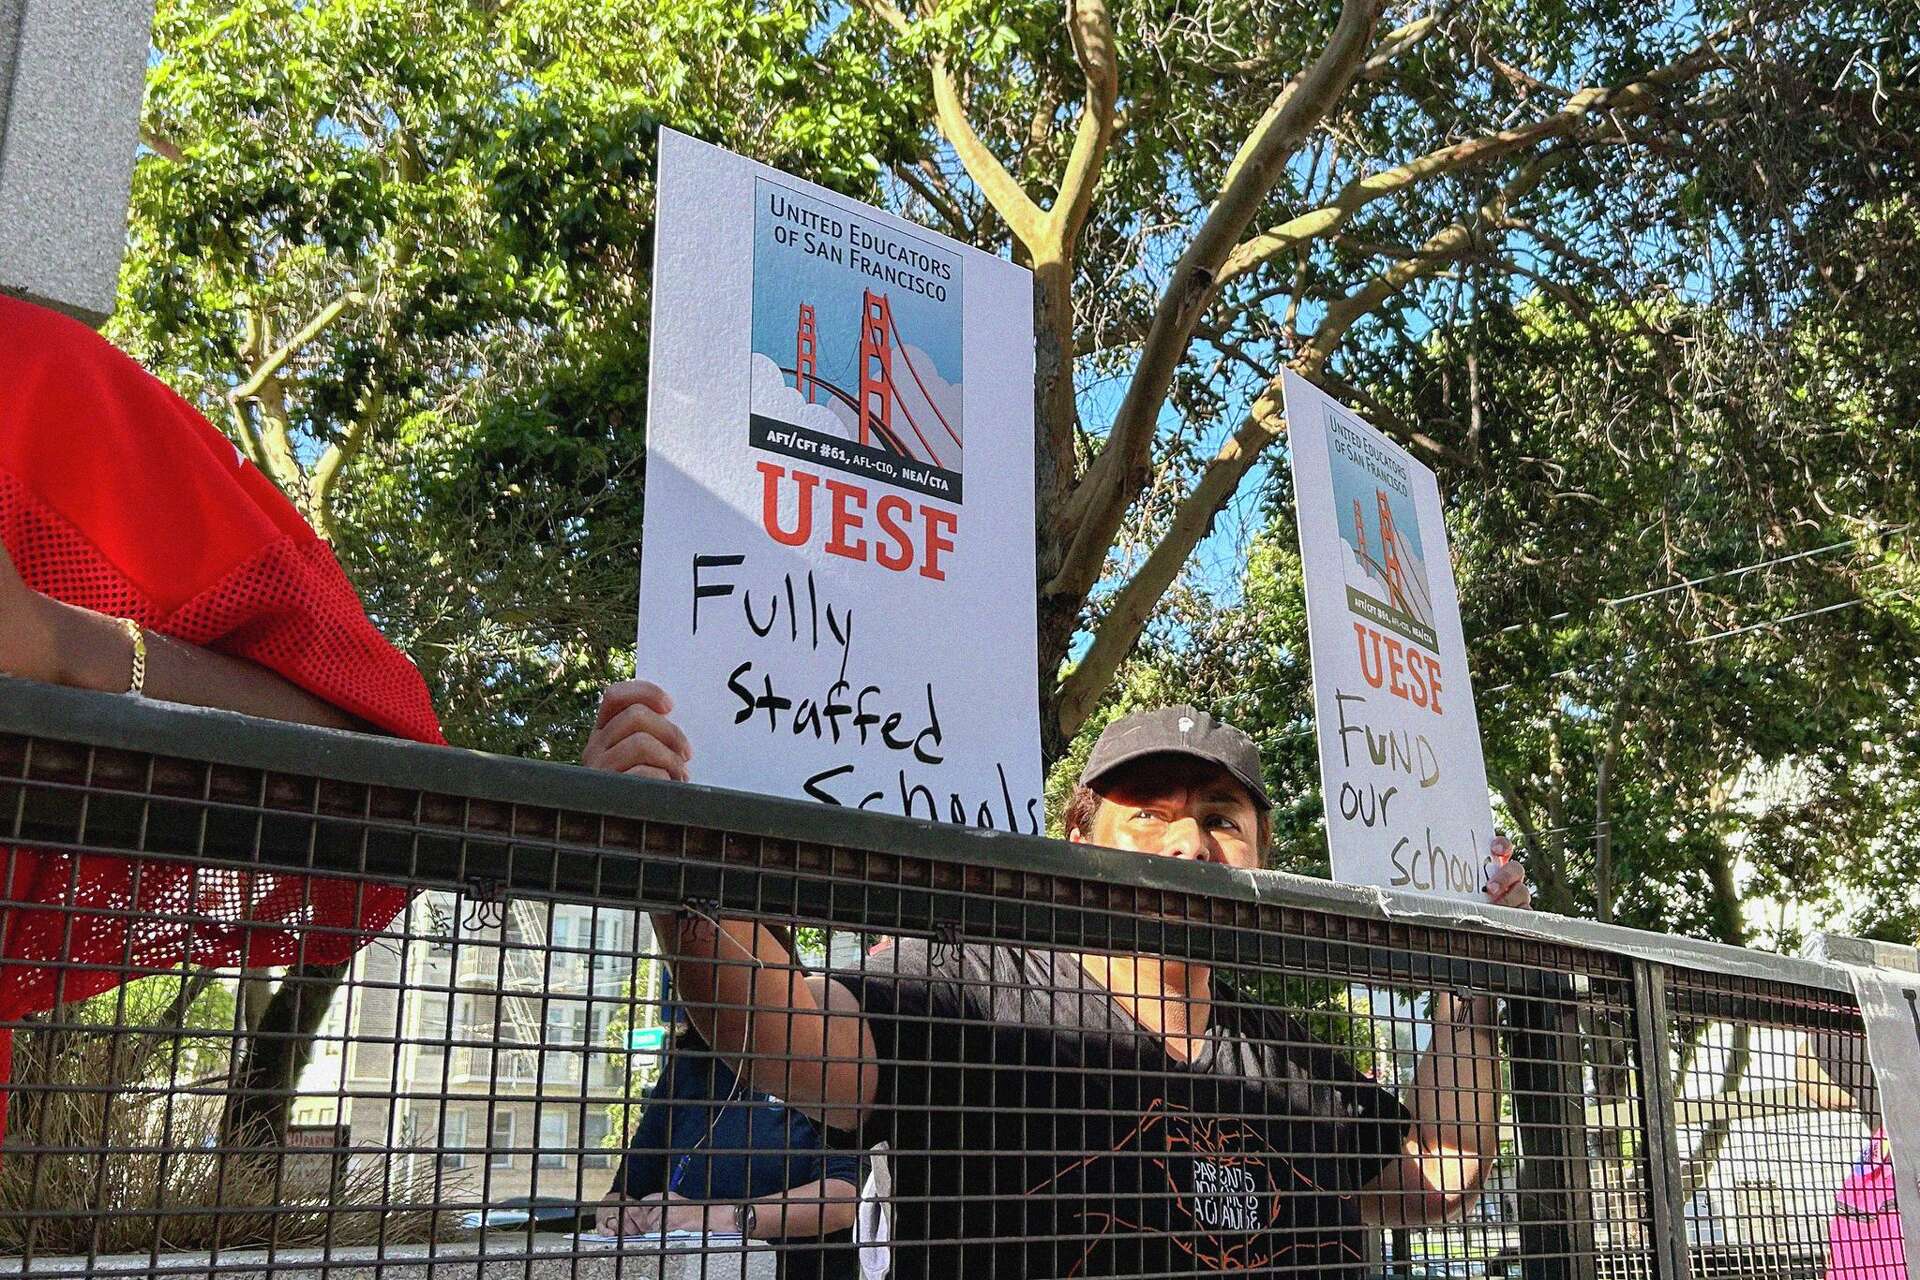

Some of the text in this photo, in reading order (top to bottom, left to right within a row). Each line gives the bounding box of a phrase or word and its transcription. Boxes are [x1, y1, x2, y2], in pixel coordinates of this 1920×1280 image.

[770, 193, 952, 280] UNITED EDUCATORS
[774, 225, 947, 303] OF SAN FRANCISCO
[766, 430, 950, 492] AFT/CFT #61, AFL-CIO, NEA/CTA
[1329, 414, 1407, 480] UNITED EDUCATORS
[1334, 439, 1346, 455] OF
[1347, 443, 1365, 469] SAN
[756, 461, 958, 581] UESF
[693, 553, 852, 695] Fully
[1353, 622, 1443, 715] UESF
[727, 661, 944, 765] Staffed
